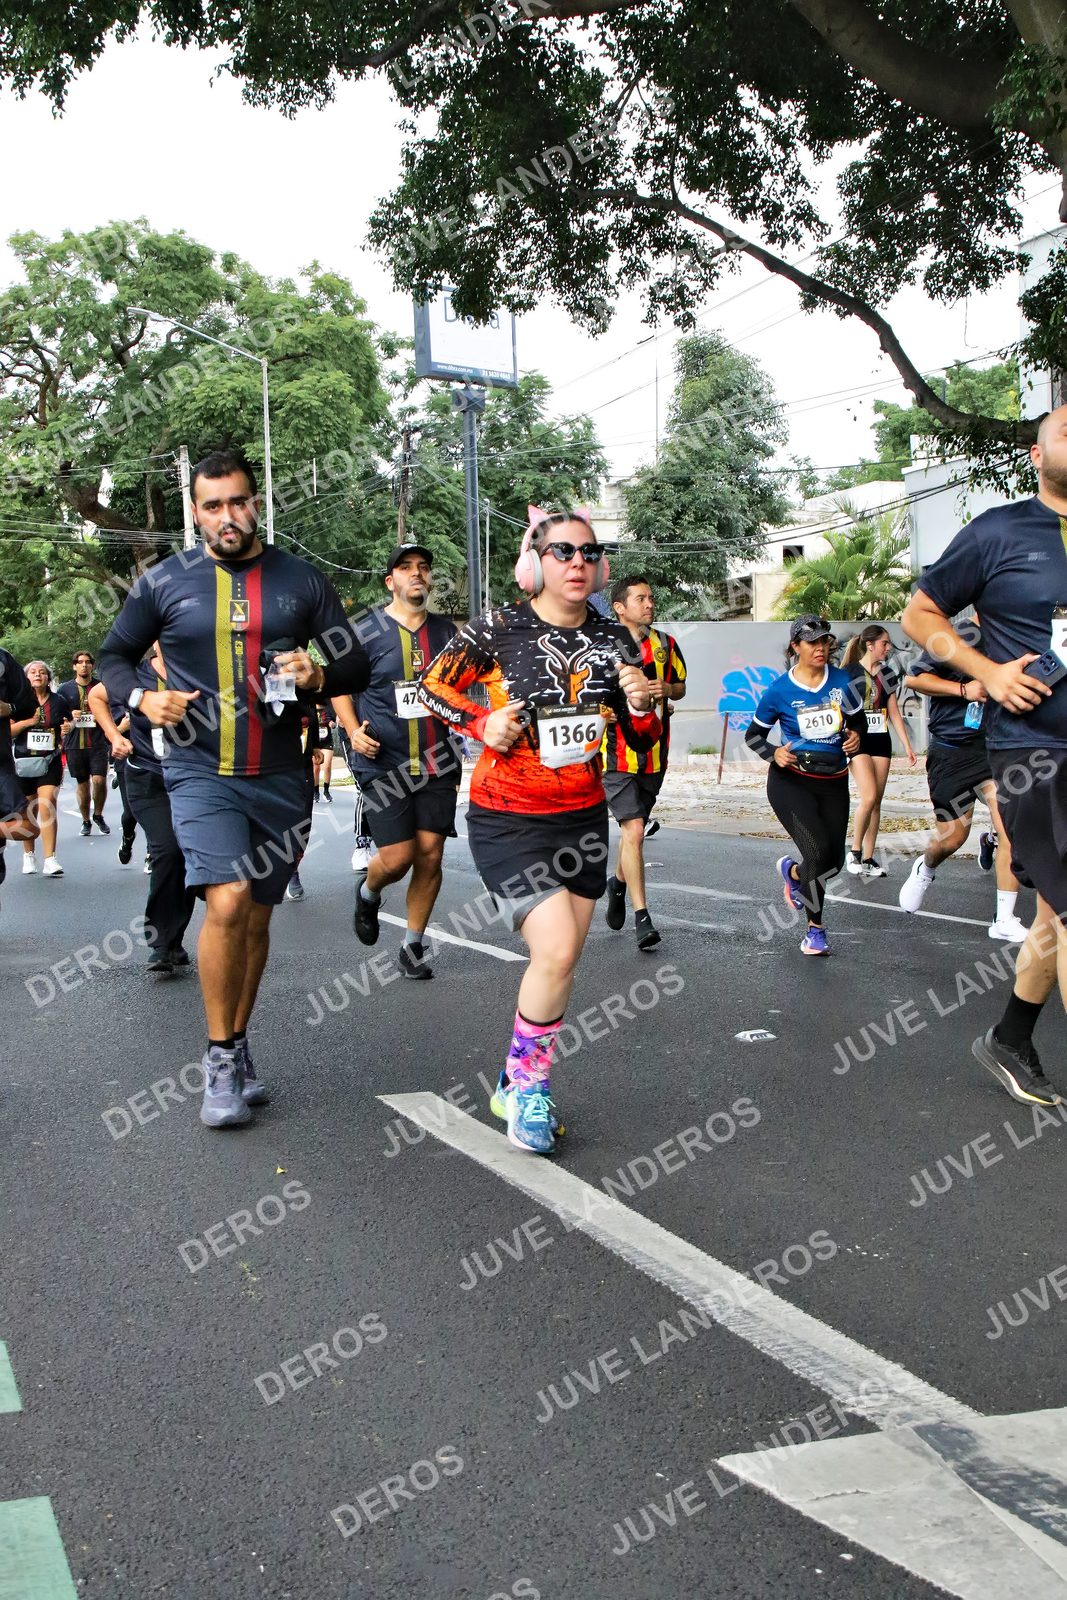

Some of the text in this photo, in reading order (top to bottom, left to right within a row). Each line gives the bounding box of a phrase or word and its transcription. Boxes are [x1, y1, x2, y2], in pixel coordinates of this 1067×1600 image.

[403, 692, 422, 705] 47
[418, 687, 461, 722] RUNNING
[804, 714, 833, 729] 2610
[32, 735, 50, 743] 1877
[549, 722, 597, 747] 1366
